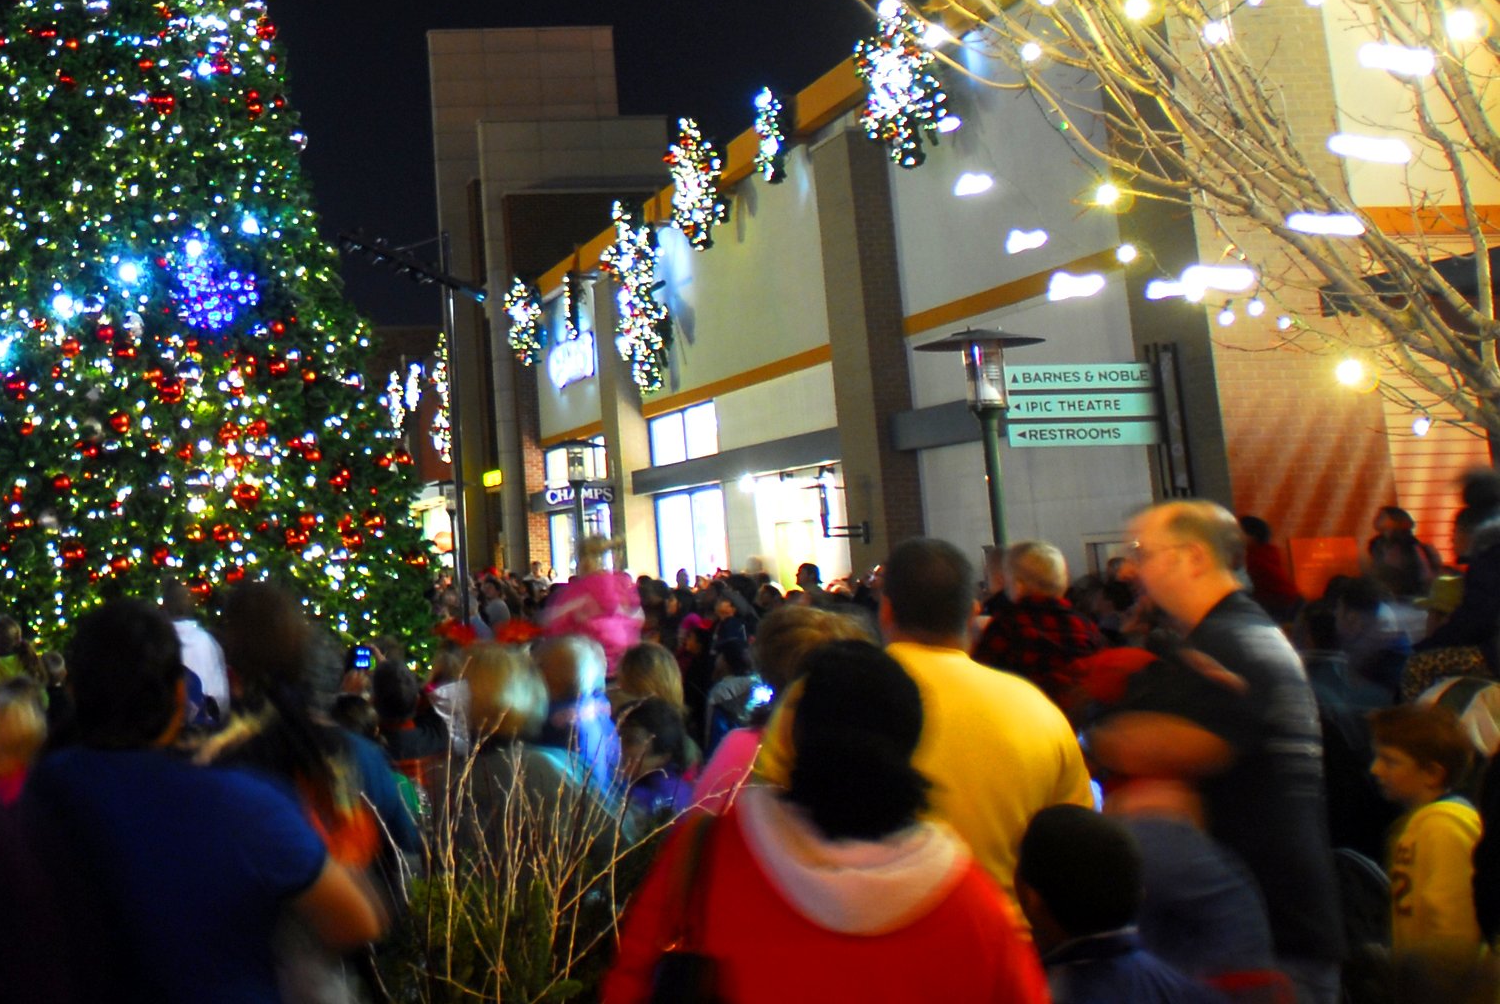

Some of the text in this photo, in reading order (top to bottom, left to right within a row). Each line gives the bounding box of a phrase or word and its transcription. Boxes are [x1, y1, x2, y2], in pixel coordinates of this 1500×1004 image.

[1021, 370, 1150, 384] BARNES & NOBLE
[1025, 399, 1122, 413] IPIC THEATRE
[1028, 427, 1122, 441] RESTROOMS
